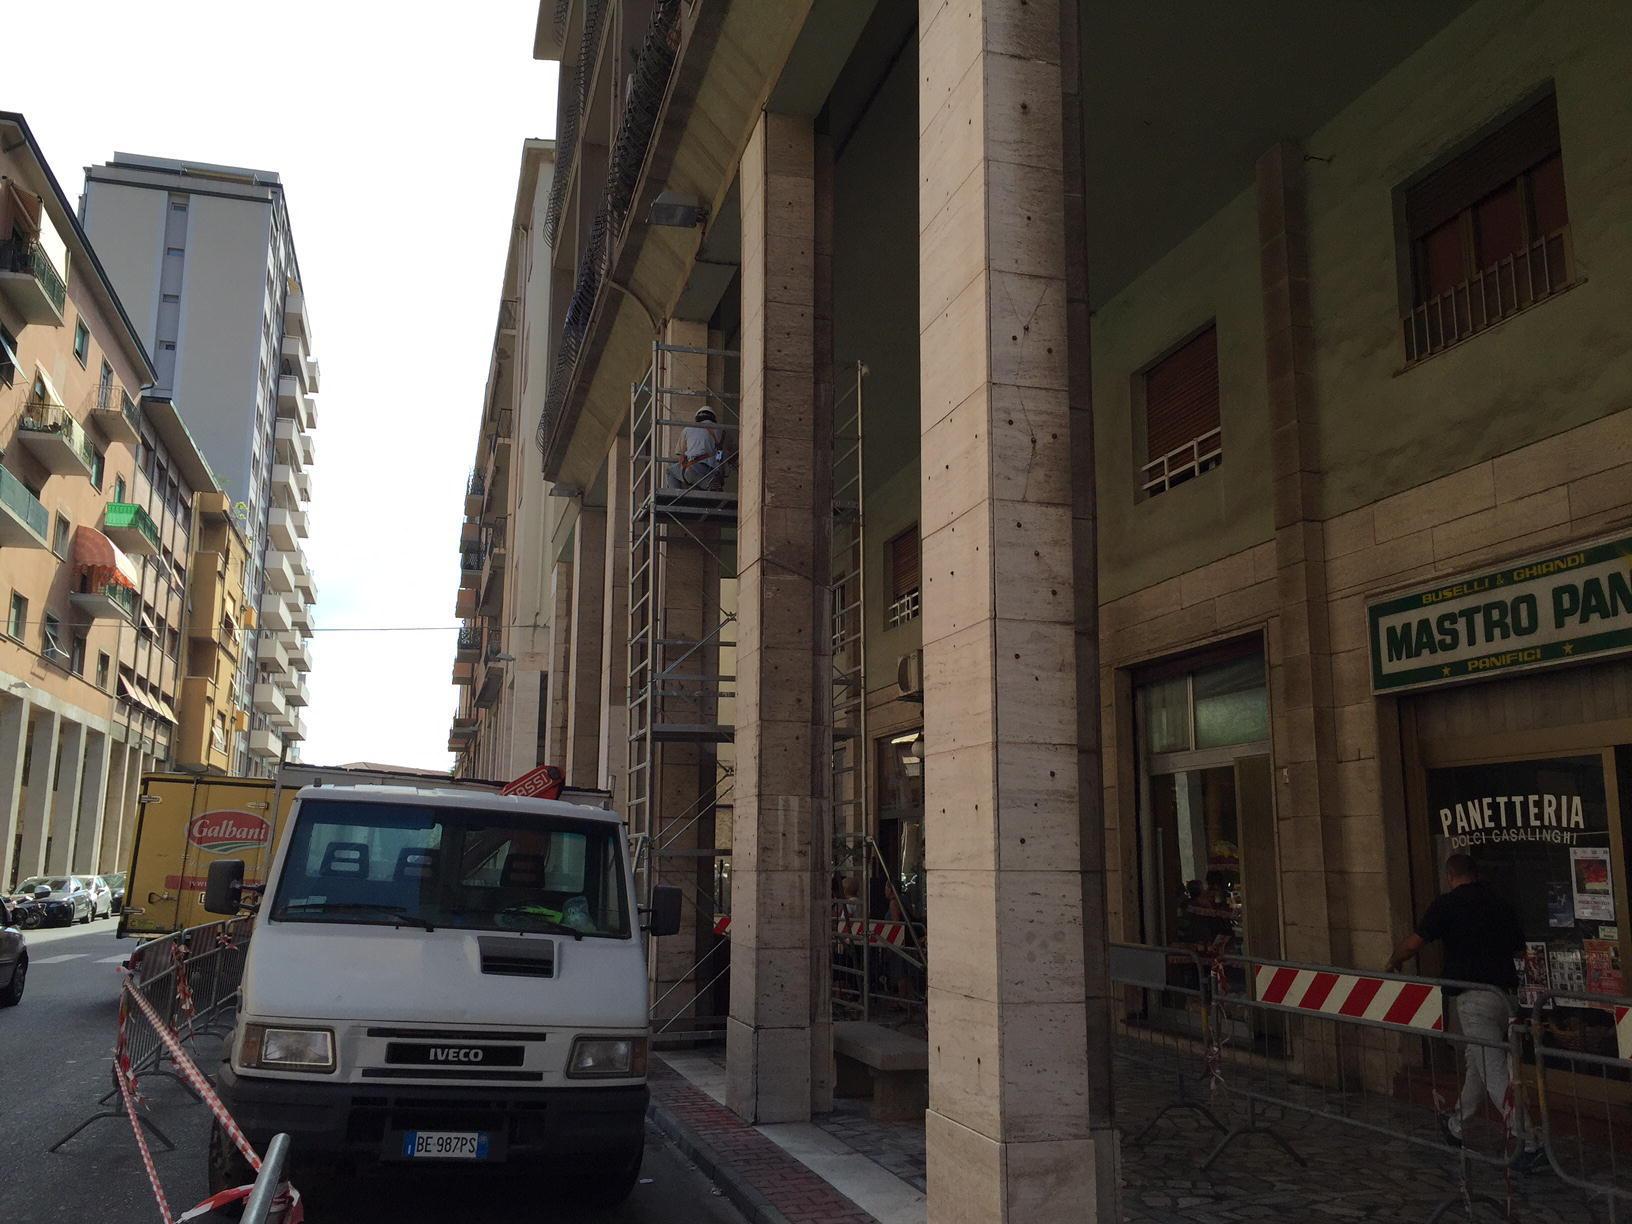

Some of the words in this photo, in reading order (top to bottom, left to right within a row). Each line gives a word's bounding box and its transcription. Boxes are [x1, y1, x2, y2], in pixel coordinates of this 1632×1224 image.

[1422, 580, 1490, 604] BUSELLI
[1496, 574, 1505, 585] &
[1513, 553, 1585, 583] GHIANDI
[1386, 593, 1538, 663] MASTRO
[1468, 649, 1542, 672] PANIFICI
[511, 773, 548, 796] ASSI
[1439, 794, 1584, 838] PANETTERIA
[192, 819, 266, 841] Galbani
[1451, 831, 1486, 849] DOLCI
[1492, 828, 1577, 845] CASALINGHI
[429, 1048, 483, 1061] IVECO
